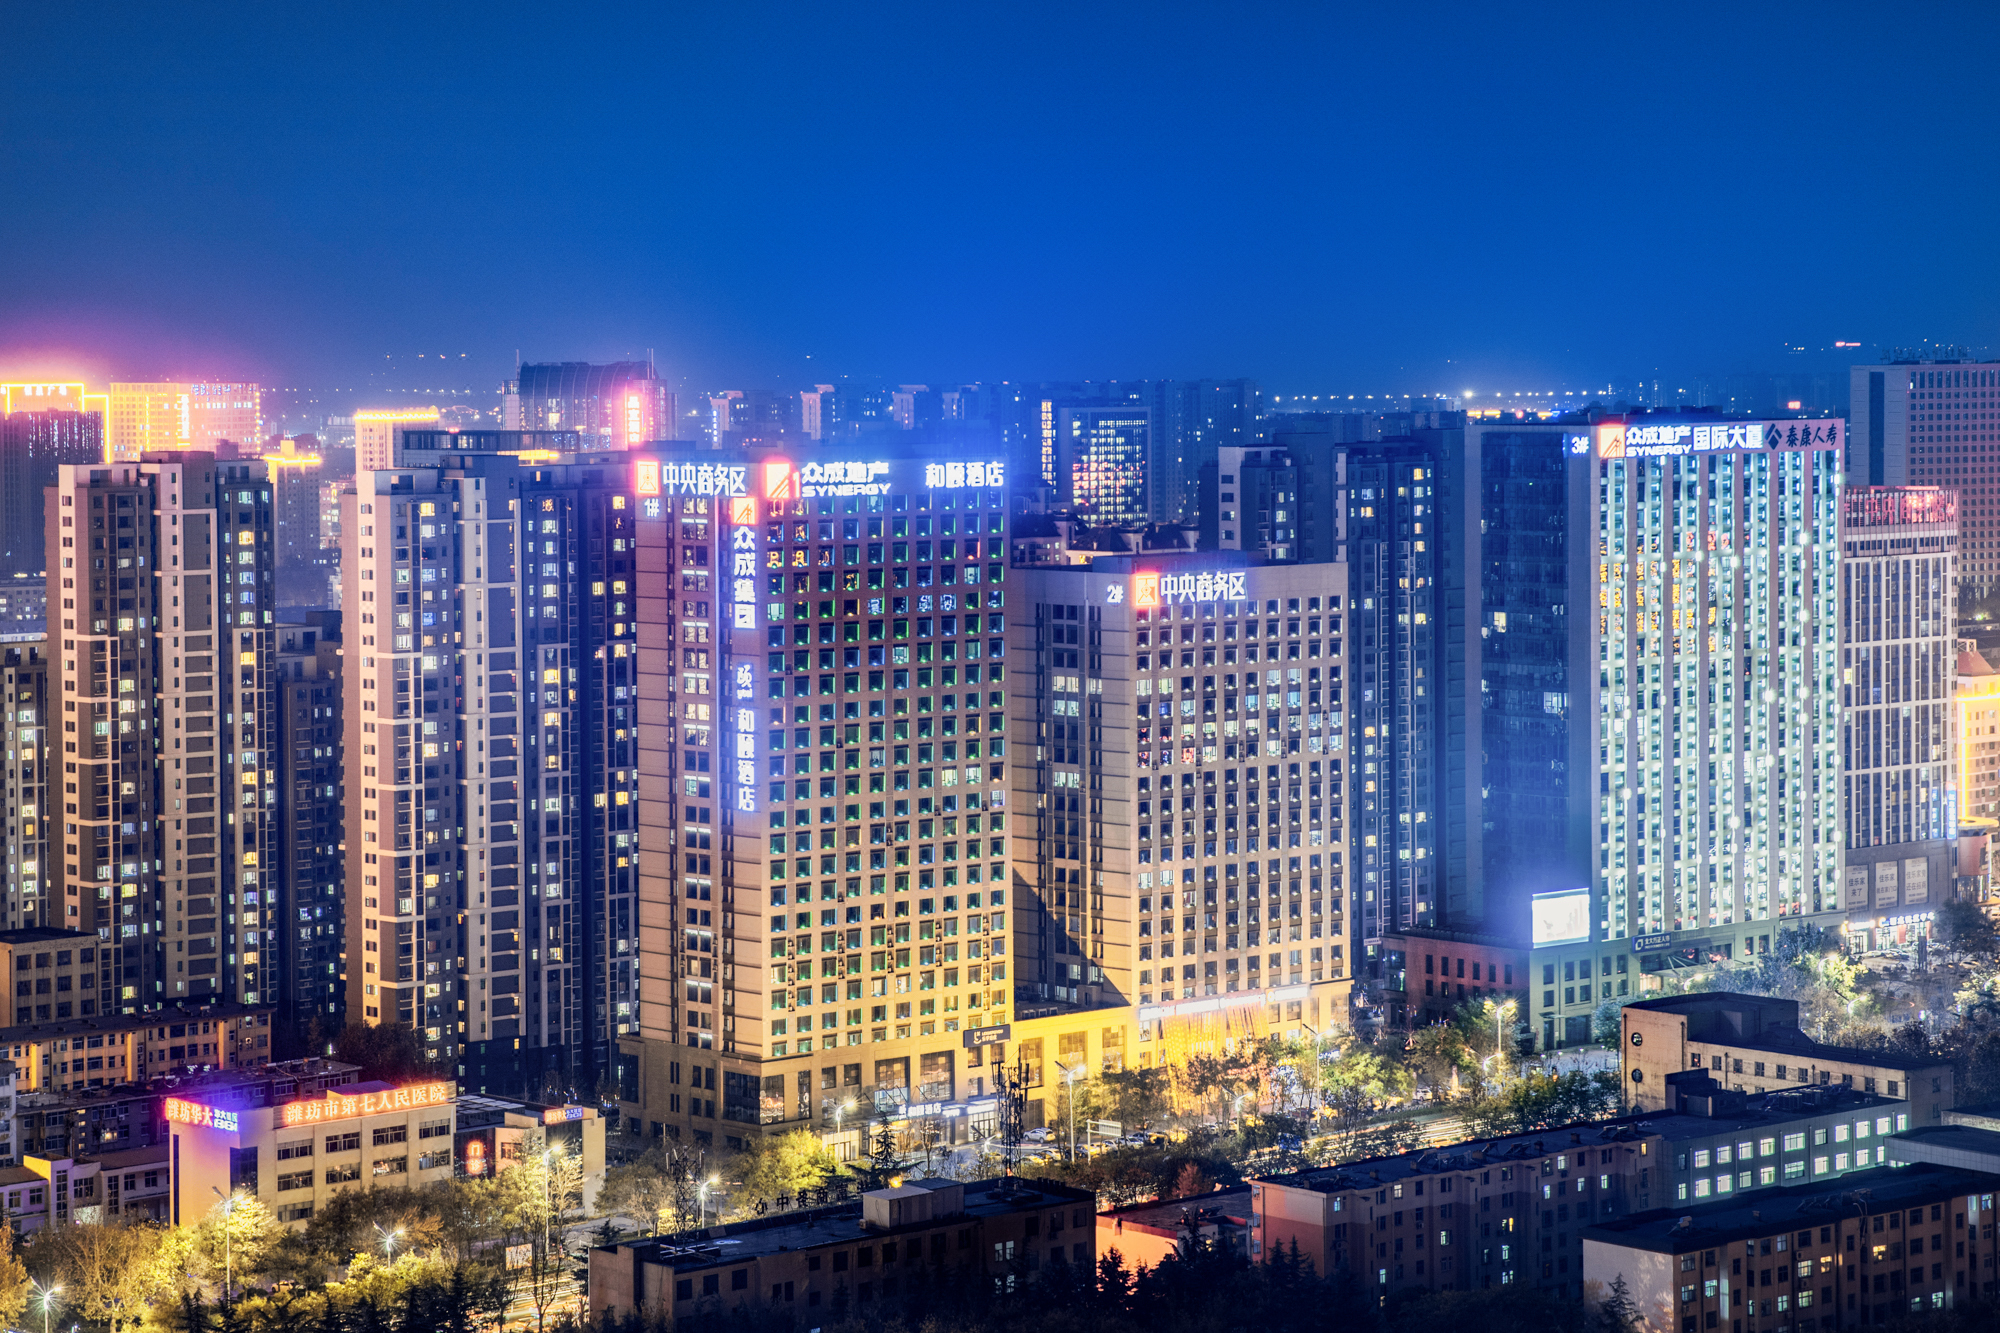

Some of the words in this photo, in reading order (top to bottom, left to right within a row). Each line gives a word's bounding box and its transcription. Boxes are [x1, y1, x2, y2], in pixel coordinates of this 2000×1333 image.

[1571, 436, 1589, 454] 3#
[1625, 426, 1691, 445] 众成地产
[1693, 424, 1764, 451] 国际大厦
[1785, 422, 1838, 448] 泰康人寿
[1625, 444, 1692, 458] SYNERGY
[662, 462, 747, 497] 中央商务区
[801, 461, 890, 484] 众成地产
[925, 461, 1004, 489] 和颐酒店
[801, 482, 892, 498] SYNERGY
[733, 525, 756, 629] 众成集团
[1160, 571, 1246, 605] 中央商务区
[1106, 584, 1124, 604] 2#
[736, 708, 755, 812] 和颐酒店
[167, 1099, 213, 1127] 潍坊华大
[286, 1084, 447, 1123] 潍坊市第七人民医院
